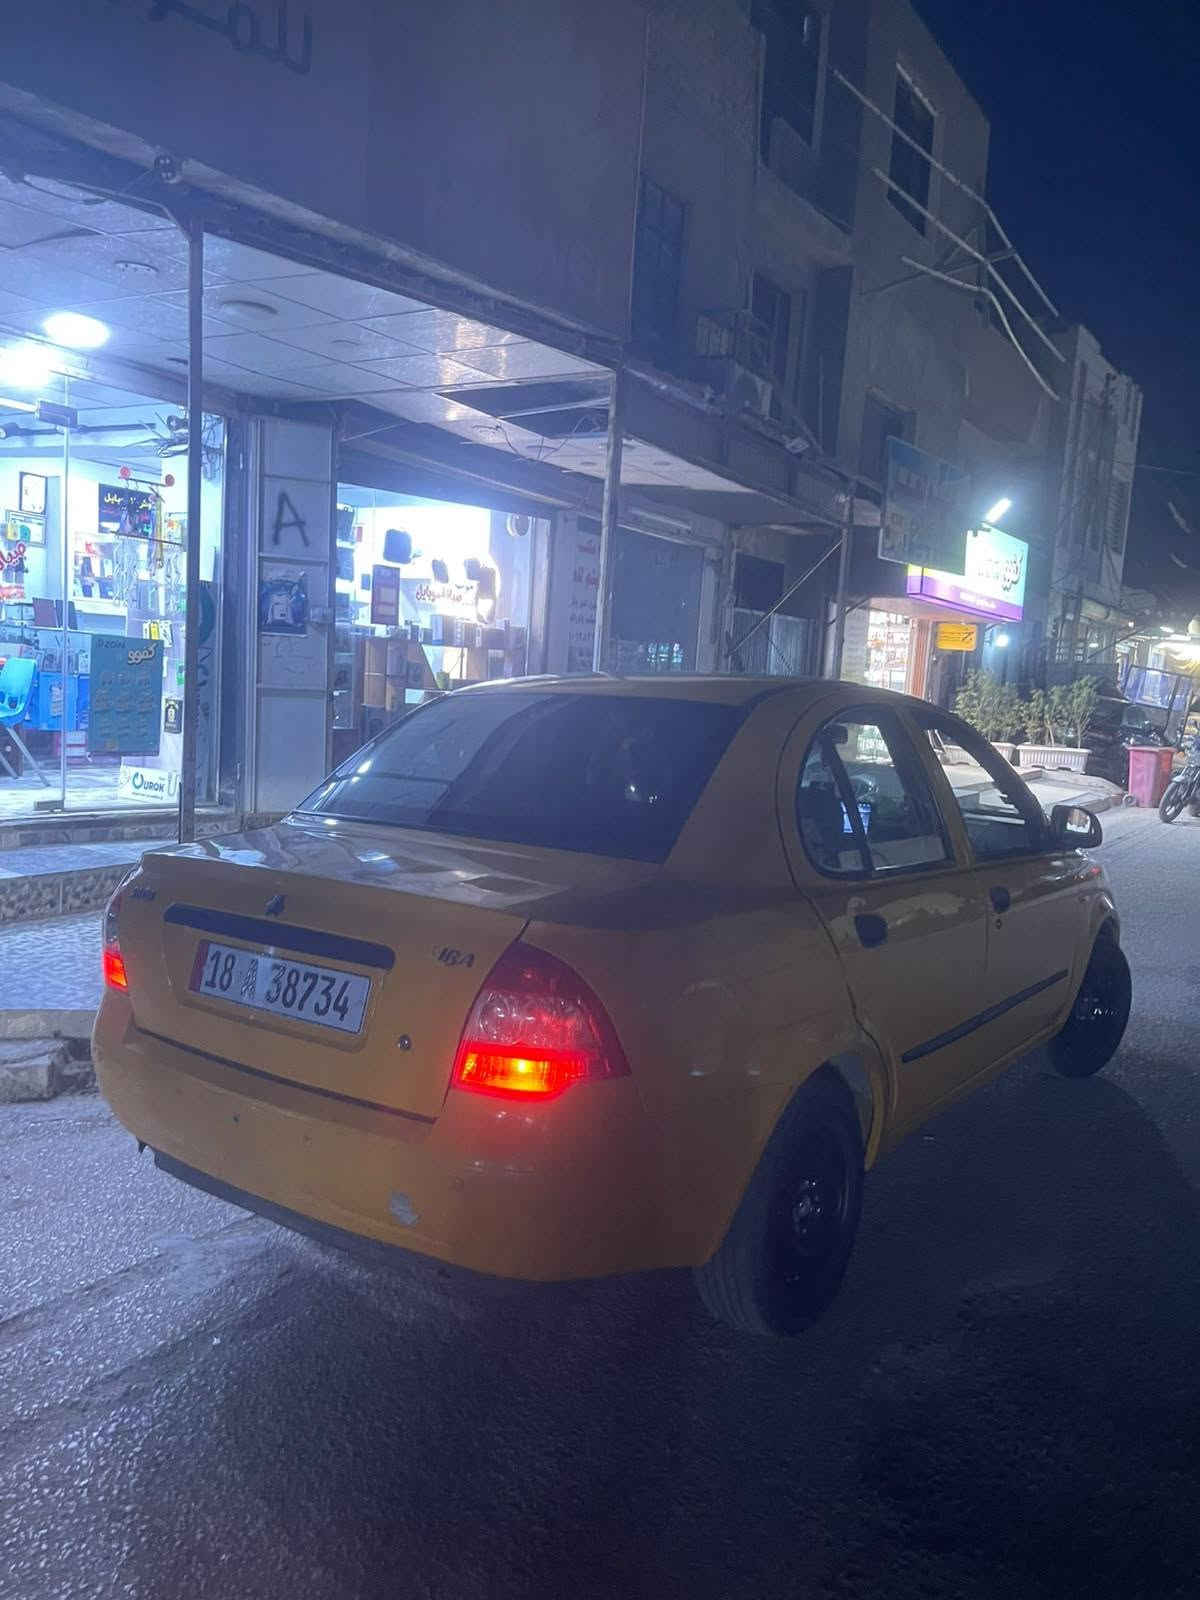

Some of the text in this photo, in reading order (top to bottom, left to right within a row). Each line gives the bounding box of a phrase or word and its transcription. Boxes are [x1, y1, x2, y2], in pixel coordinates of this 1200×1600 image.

[272, 492, 310, 547] A
[204, 950, 237, 992] 18
[265, 961, 350, 1022] 38734
